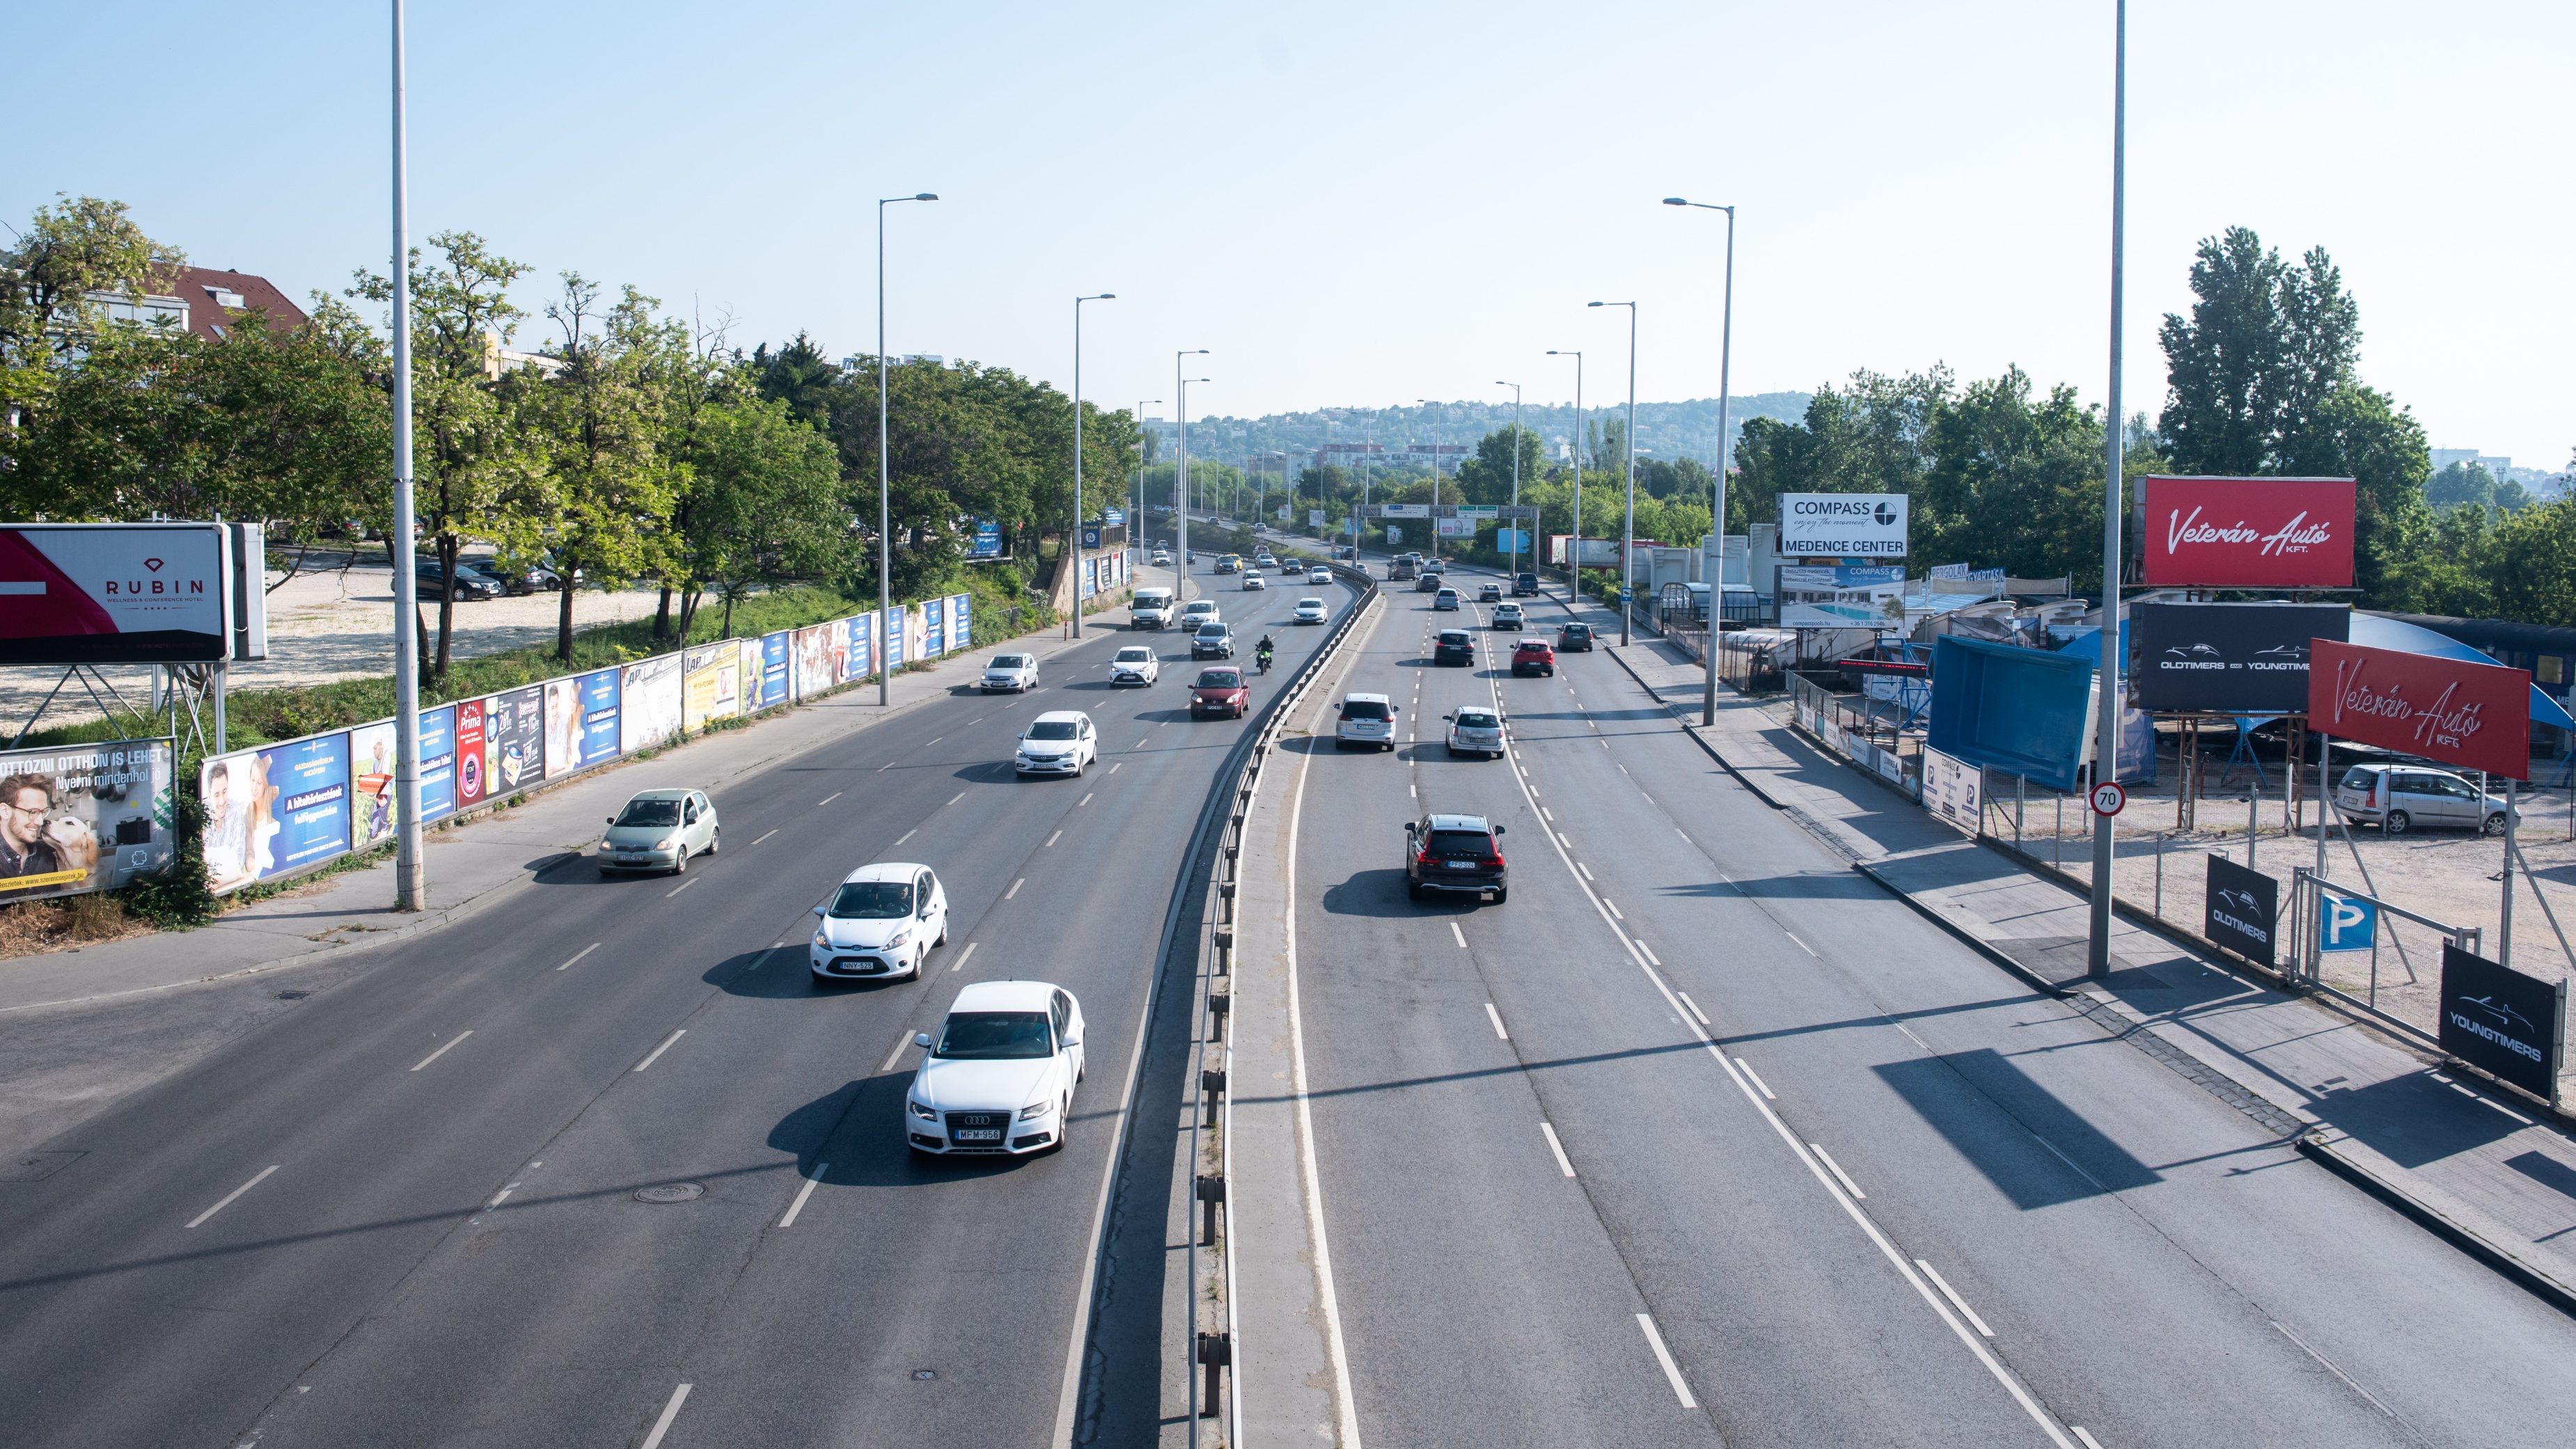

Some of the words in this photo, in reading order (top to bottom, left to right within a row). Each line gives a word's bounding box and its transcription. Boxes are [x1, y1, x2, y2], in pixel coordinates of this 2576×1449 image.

[1795, 502, 1870, 515] COMPASS
[1793, 518, 1818, 533] enjoy
[1818, 517, 1832, 528] the
[1832, 518, 1871, 526] moment
[2168, 506, 2259, 555] Veterán
[2261, 510, 2330, 556] Autó
[1786, 540, 1848, 551] MEDENCE
[1853, 541, 1903, 552] CENTER
[1850, 567, 1890, 576] COMPASS
[107, 580, 203, 595] RUBIN
[686, 648, 716, 674] LAPTOP
[625, 661, 658, 687] APTOP
[2334, 658, 2412, 725] Veterán
[2414, 681, 2484, 747] Autó
[460, 714, 482, 731] Príma
[0, 756, 55, 776] OTTÓZNI
[58, 753, 109, 771] OTTHON
[111, 751, 124, 765] IS
[127, 749, 163, 765] LEHET
[56, 774, 91, 792] Nyerni
[94, 769, 148, 787] mindenhol
[150, 769, 162, 785] jó
[287, 799, 293, 811] A
[2100, 793, 2116, 806] 70
[25, 871, 84, 886] www.szerencsejatek.hu
[2213, 909, 2267, 943] OLDTIMERS
[2330, 902, 2365, 944] P
[2450, 1011, 2542, 1063] YOUNGTIMERS
[960, 1129, 998, 1138] MFM-956
